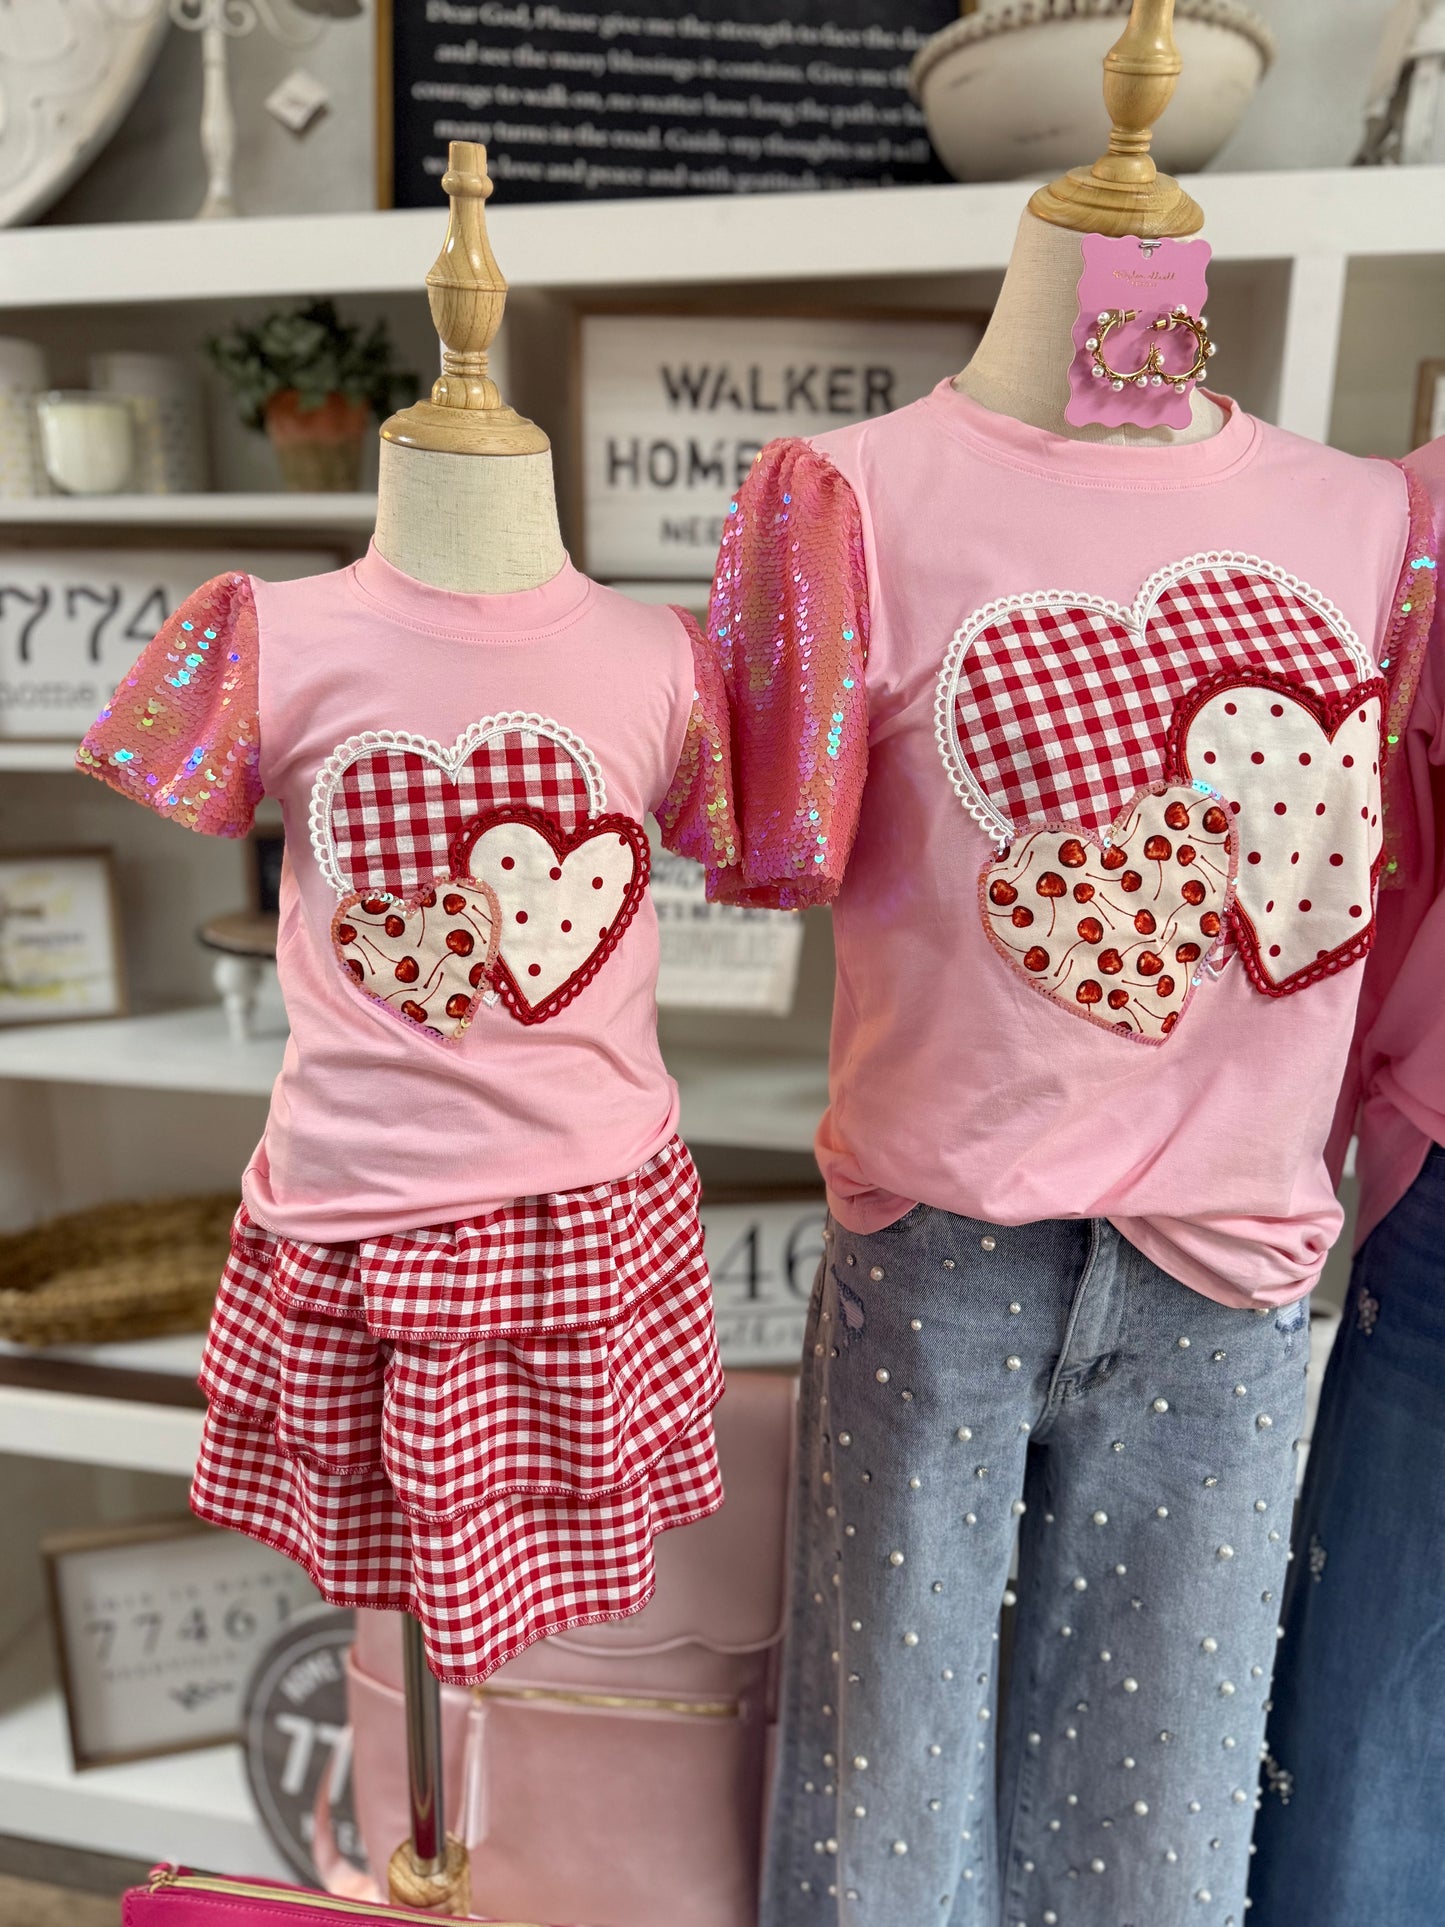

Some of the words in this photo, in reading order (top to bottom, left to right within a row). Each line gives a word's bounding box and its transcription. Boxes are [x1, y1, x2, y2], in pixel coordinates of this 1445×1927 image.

[534, 4, 598, 33] Please
[598, 12, 642, 40] give
[677, 13, 712, 40] the
[434, 38, 478, 64] and
[512, 42, 548, 69] the
[806, 60, 855, 87] Give
[661, 362, 897, 415] WALKER
[82, 1591, 292, 1663] 77461
